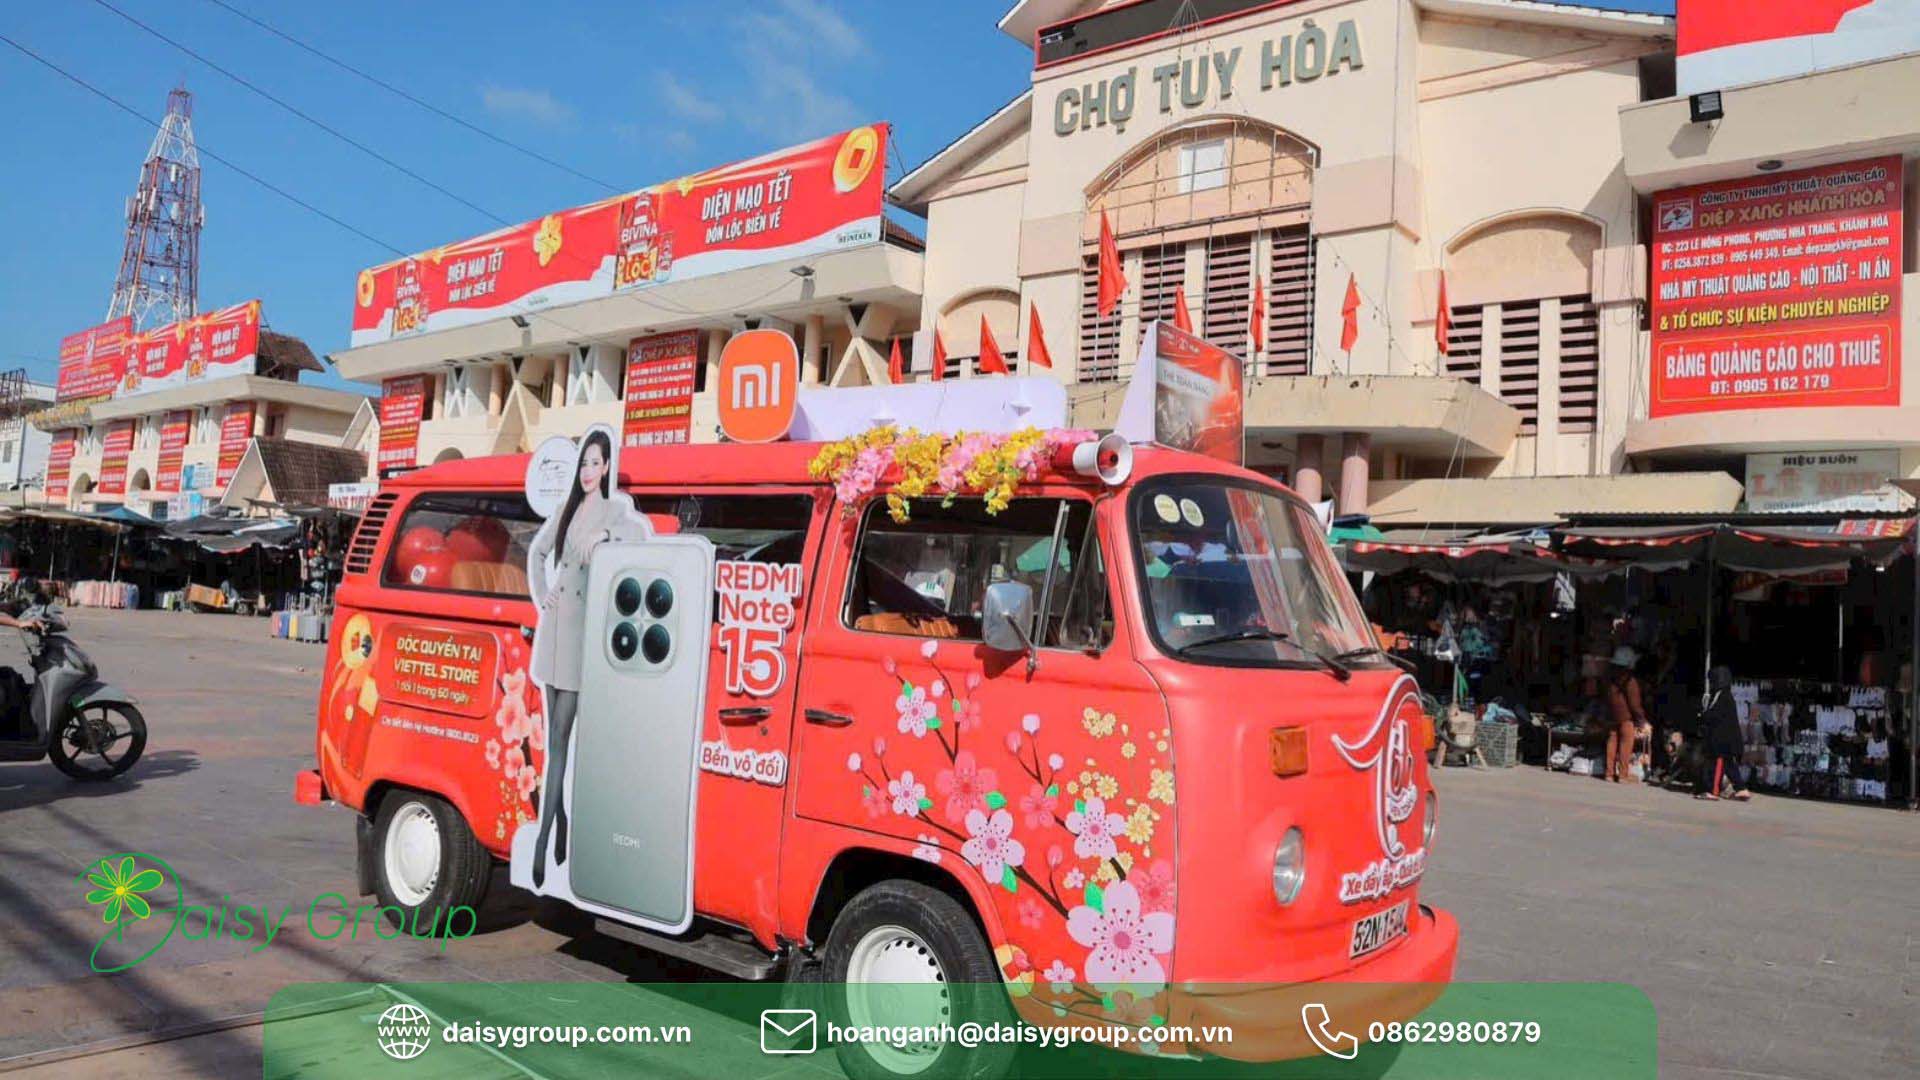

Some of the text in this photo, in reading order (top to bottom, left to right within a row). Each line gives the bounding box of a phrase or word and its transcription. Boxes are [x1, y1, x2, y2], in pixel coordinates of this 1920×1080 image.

[1054, 18, 1364, 137] CHỢ TUY HÒA
[702, 168, 793, 221] DIỆN MẠO TẾT
[621, 222, 658, 243] BIVINA
[1733, 267, 1767, 294] QUẢNG
[1769, 265, 1791, 289] CÁO
[1859, 261, 1871, 280] IN
[1659, 315, 1669, 331] &
[1747, 303, 1778, 326] KIỆN
[1781, 297, 1834, 319] CHUYÊN
[1838, 293, 1890, 316] NGHIỆP
[1666, 334, 1882, 379] BẢNG QUẢNG CÁO CHO THUÊ
[1734, 378, 1768, 393] 0905
[1773, 376, 1798, 391] 162
[1804, 374, 1830, 389] 179
[716, 563, 799, 594] REDMI
[720, 593, 791, 624] Note
[394, 658, 479, 685] VIETTEL STORE
[721, 626, 781, 692] 15
[702, 747, 729, 769] Bền
[755, 755, 780, 778] đối
